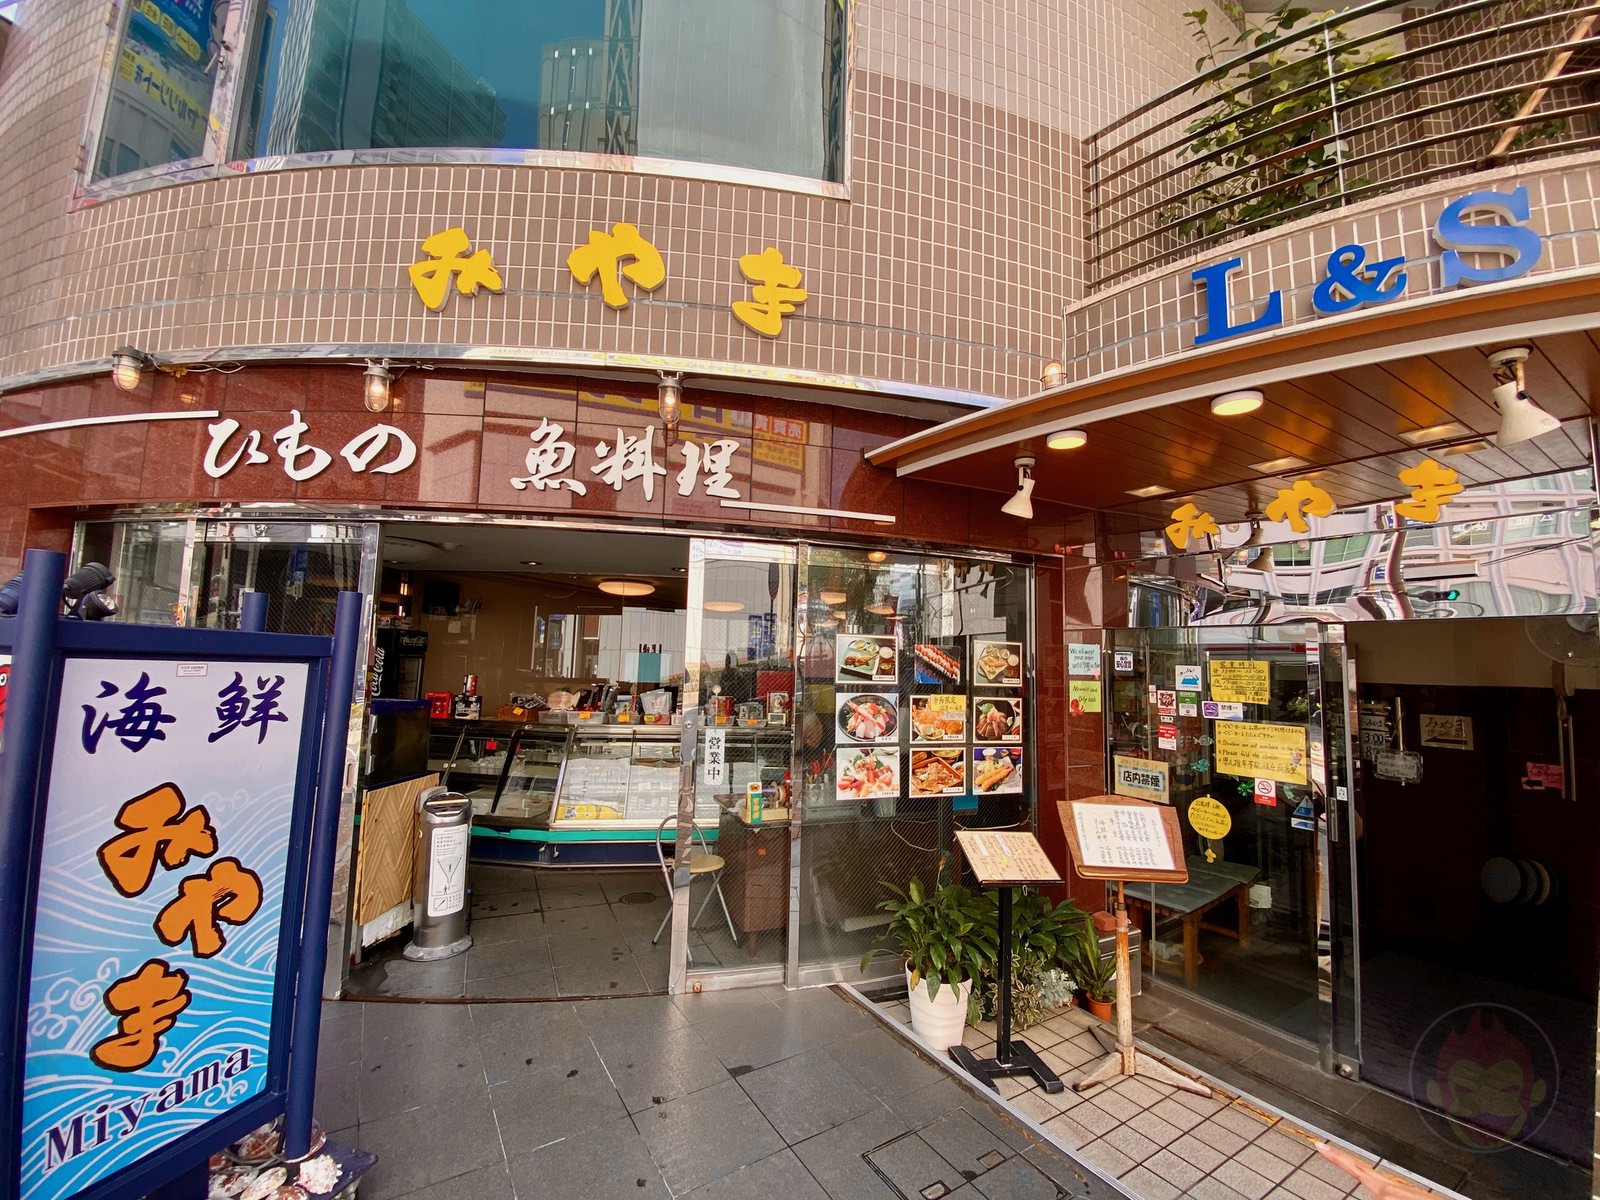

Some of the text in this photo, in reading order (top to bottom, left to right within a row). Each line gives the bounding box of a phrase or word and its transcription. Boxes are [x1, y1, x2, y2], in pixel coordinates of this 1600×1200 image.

[408, 222, 808, 338] みやま
[203, 409, 417, 481] ひもの
[510, 416, 741, 501] 魚料理
[1165, 459, 1464, 549] みやま
[80, 669, 288, 754] 海鮮
[707, 736, 721, 780] 営業中
[1123, 770, 1160, 787] 店内禁煙
[90, 780, 263, 1072] みやま
[41, 1044, 253, 1175] Miyama
